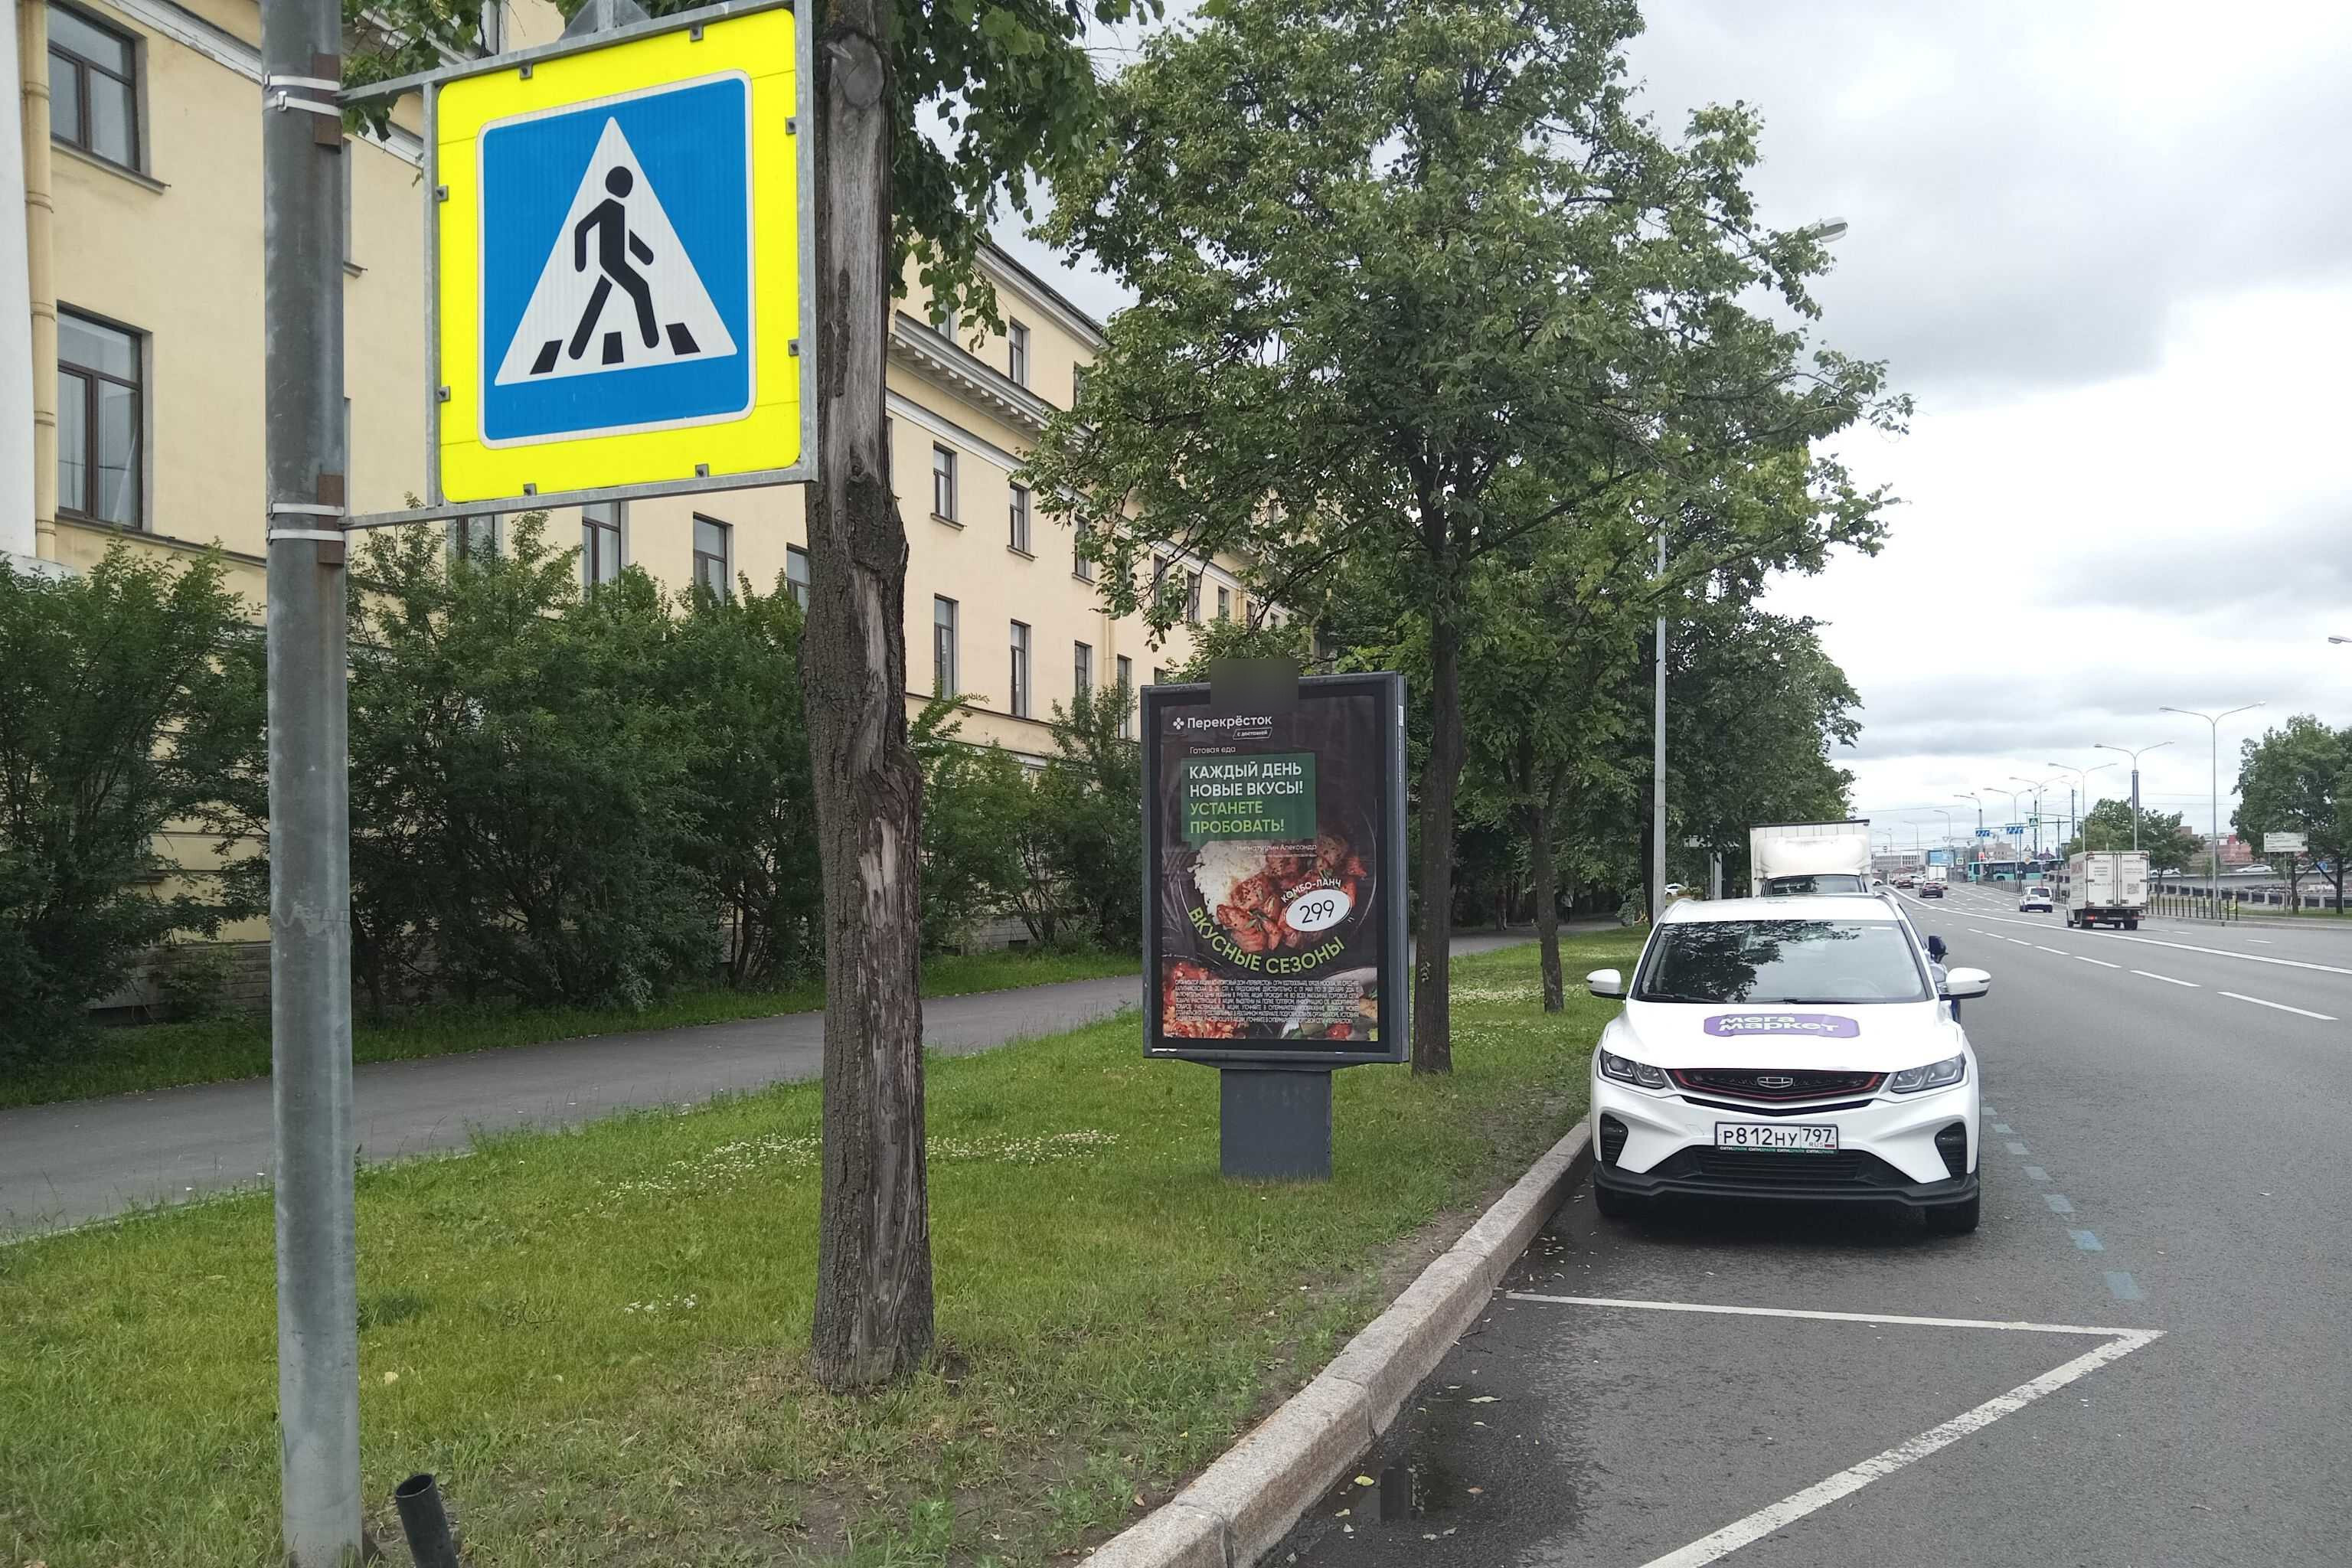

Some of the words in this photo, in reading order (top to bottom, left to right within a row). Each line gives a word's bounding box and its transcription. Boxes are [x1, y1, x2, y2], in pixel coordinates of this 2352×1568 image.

[1187, 715, 1272, 730] Перекрёсток
[1189, 761, 1258, 779] КАЖДЫЙ
[1262, 762, 1302, 779] ДЕНЬ
[1190, 782, 1243, 797] НОВЫЕ
[1246, 780, 1303, 795] ВКУСЫ!
[1190, 801, 1263, 815] УСТАНЕТЕ
[1190, 818, 1285, 833] ПРОБОВАТЬ!
[1281, 878, 1341, 903] КОМБО-ЛАНЧ
[1299, 900, 1334, 923] 299
[1188, 906, 1263, 971] ВКУСНЫЕ
[1266, 936, 1345, 974] СЕЗОНЫ
[1719, 1022, 1838, 1031] маркет
[1720, 1016, 1795, 1024] мега
[1723, 1127, 1798, 1146] Р812НУ
[1802, 1128, 1832, 1143] 797
